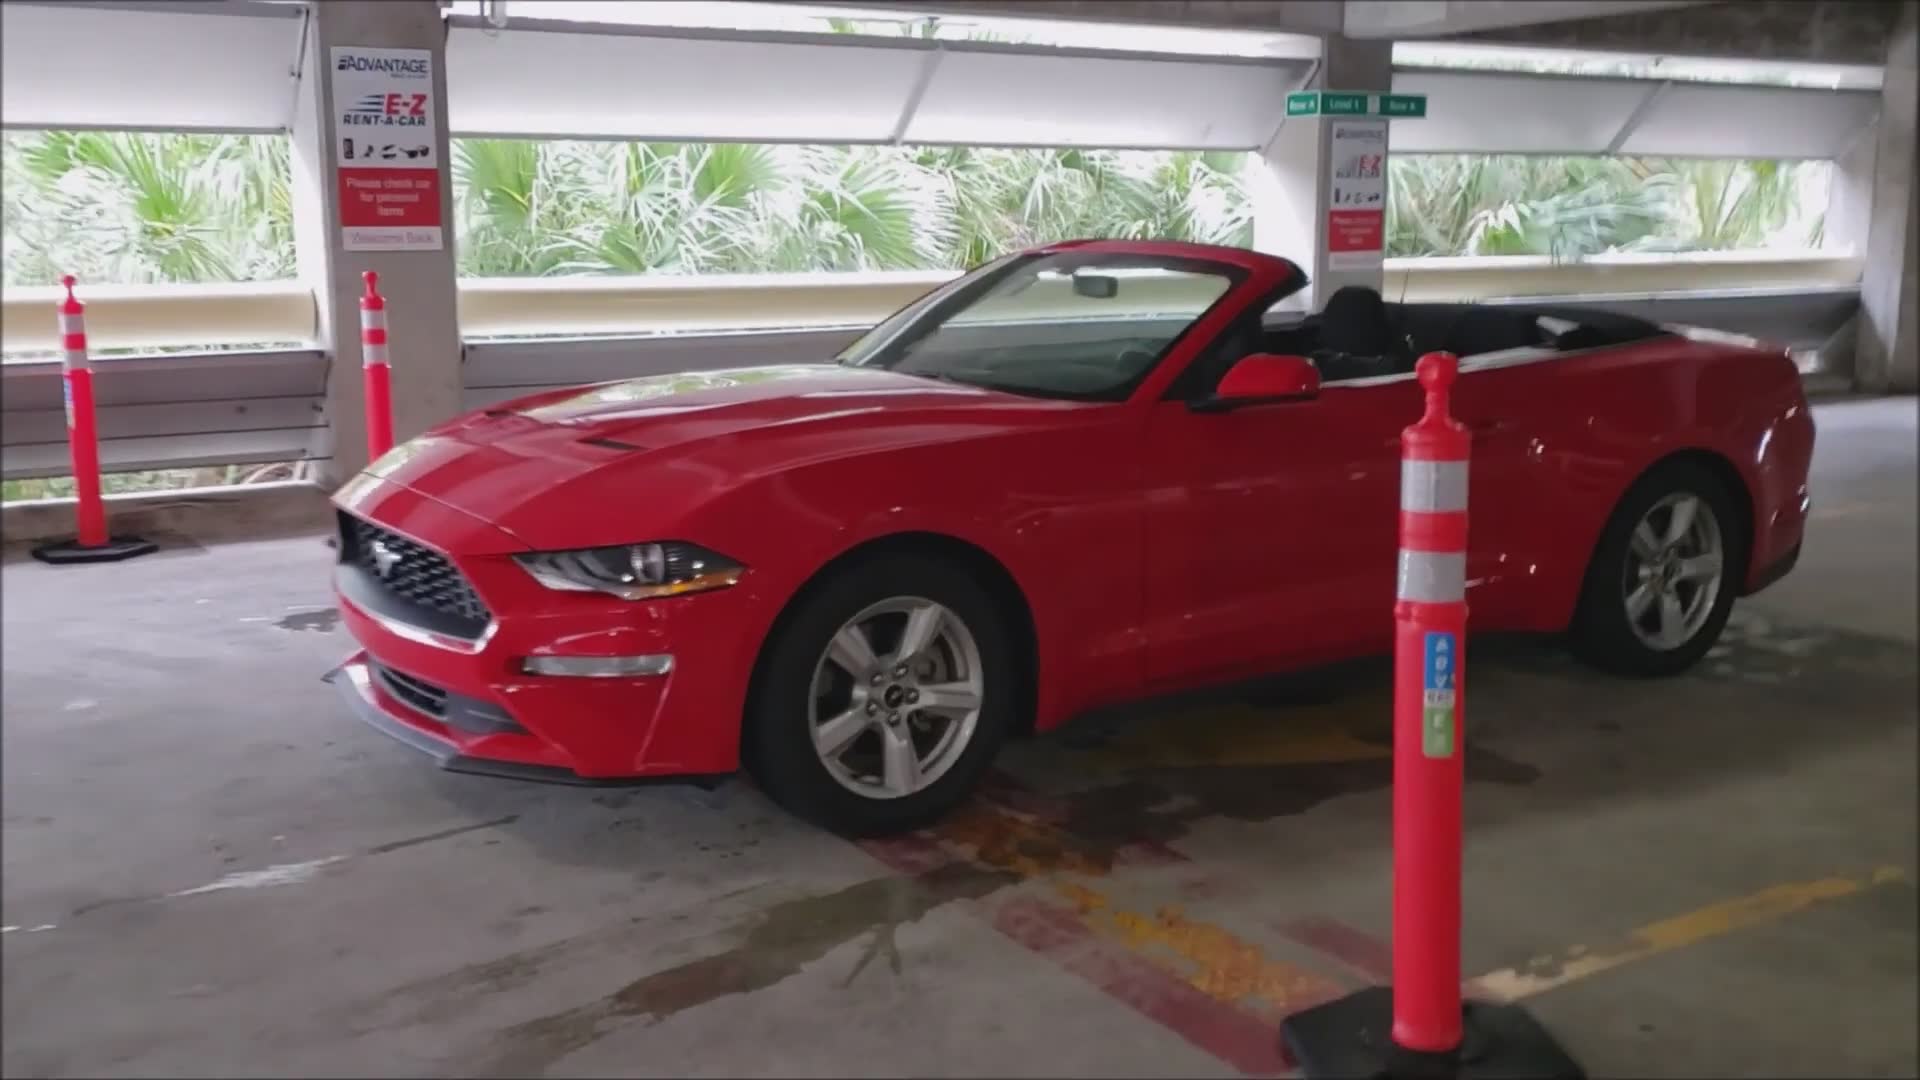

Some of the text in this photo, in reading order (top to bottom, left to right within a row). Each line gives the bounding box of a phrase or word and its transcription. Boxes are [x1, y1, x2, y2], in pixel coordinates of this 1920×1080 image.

[345, 55, 428, 73] ADVANTAGE
[385, 93, 428, 116] E-Z
[343, 114, 426, 126] RENT-A-CAR
